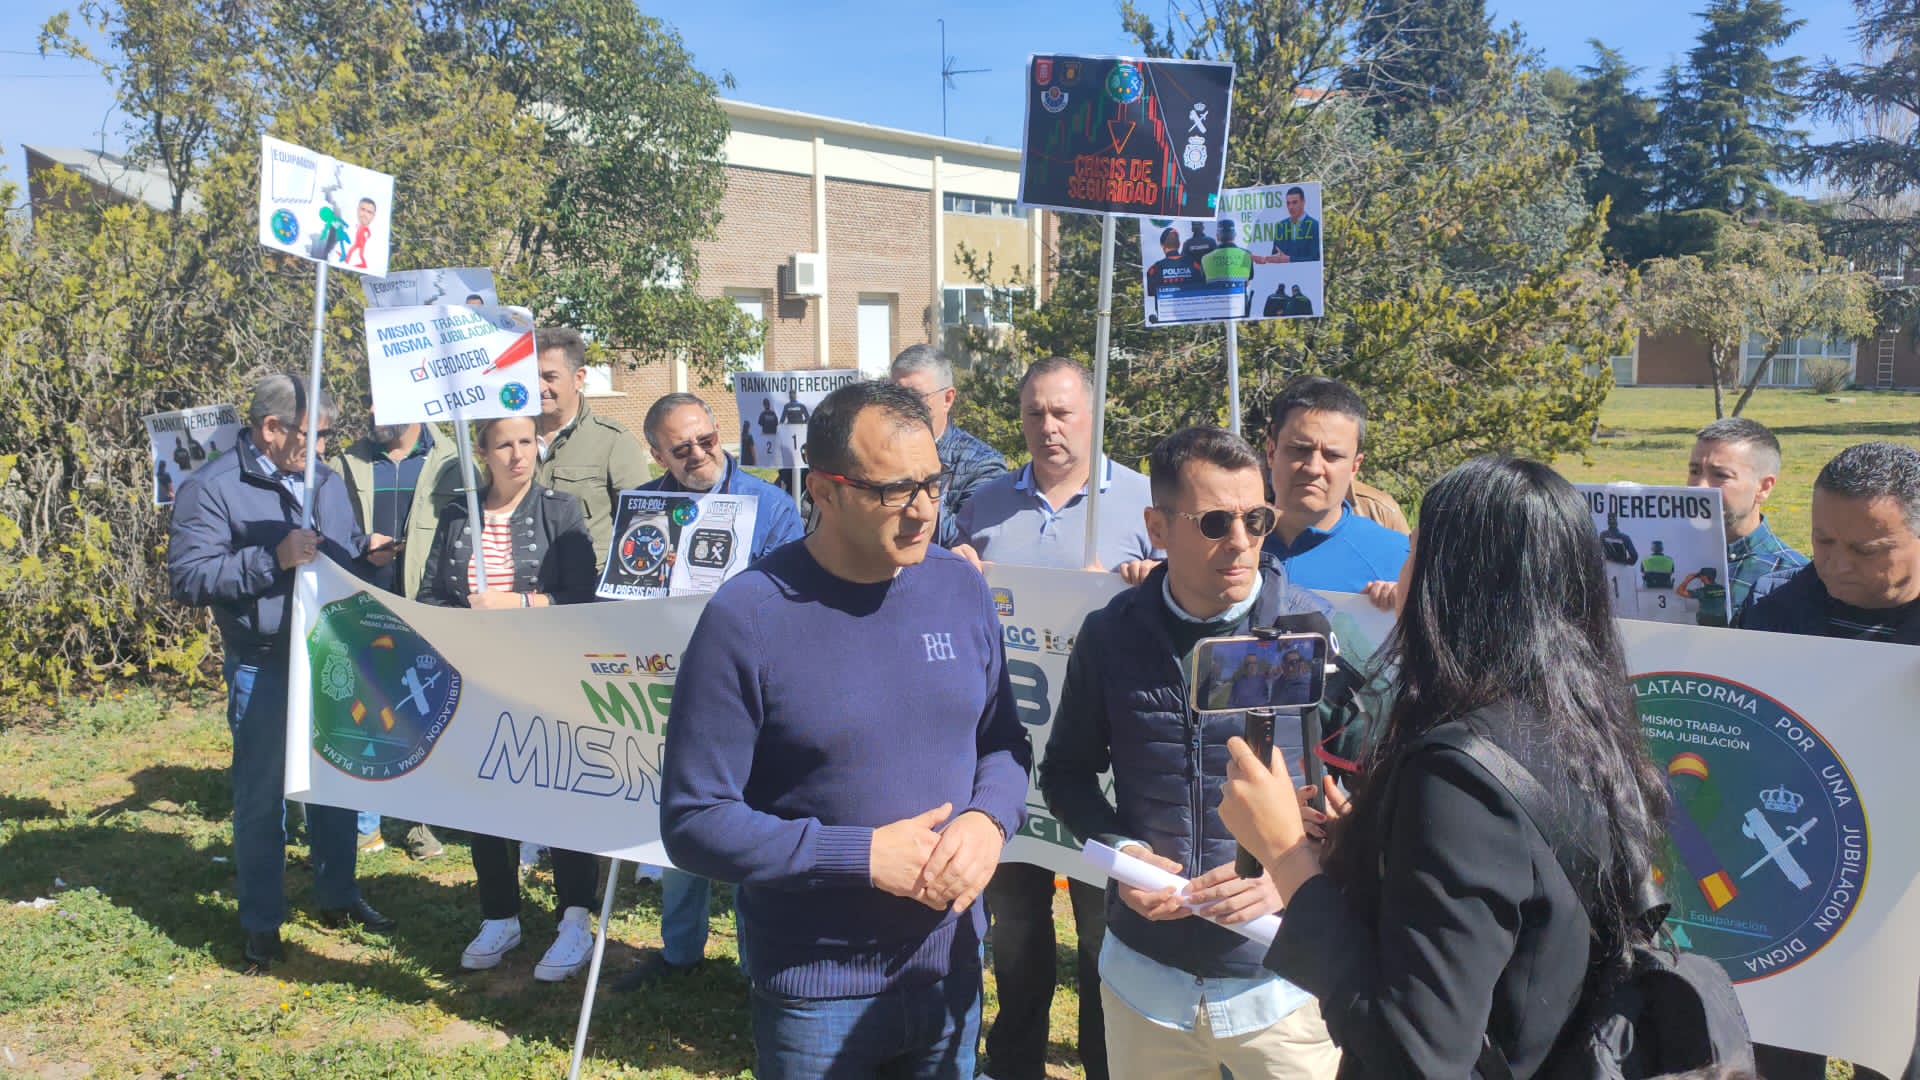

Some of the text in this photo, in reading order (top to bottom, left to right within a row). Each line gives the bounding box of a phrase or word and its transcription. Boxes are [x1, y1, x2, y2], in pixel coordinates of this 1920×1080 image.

[1074, 154, 1153, 183] CRISIS DE
[1067, 175, 1158, 206] SEGURIDAD
[1219, 191, 1282, 213] AVORITOS
[1241, 212, 1252, 224] DE
[1243, 219, 1313, 244] SÁNCHEZ
[377, 321, 425, 341] MISMO
[431, 311, 484, 330] TRABAJO
[382, 337, 433, 358] MISMA
[427, 347, 490, 378] VERDADERO
[741, 376, 787, 393] RANKING
[444, 385, 486, 411] FALSO
[766, 441, 772, 454] 2
[791, 434, 797, 450] 1
[1609, 494, 1712, 519] DERECHOS
[1611, 576, 1619, 599] 1
[1658, 595, 1666, 609] 3
[635, 653, 675, 672] AIGC
[1642, 713, 1742, 736] MISMO TRABAJO
[323, 743, 353, 771] PLENA
[398, 746, 425, 771] DIGNA
[362, 766, 374, 776] LA
[383, 766, 391, 776] Y
[1629, 680, 1862, 973] LATAFORMA POR UNA JUBILACIÓN DIGNA
